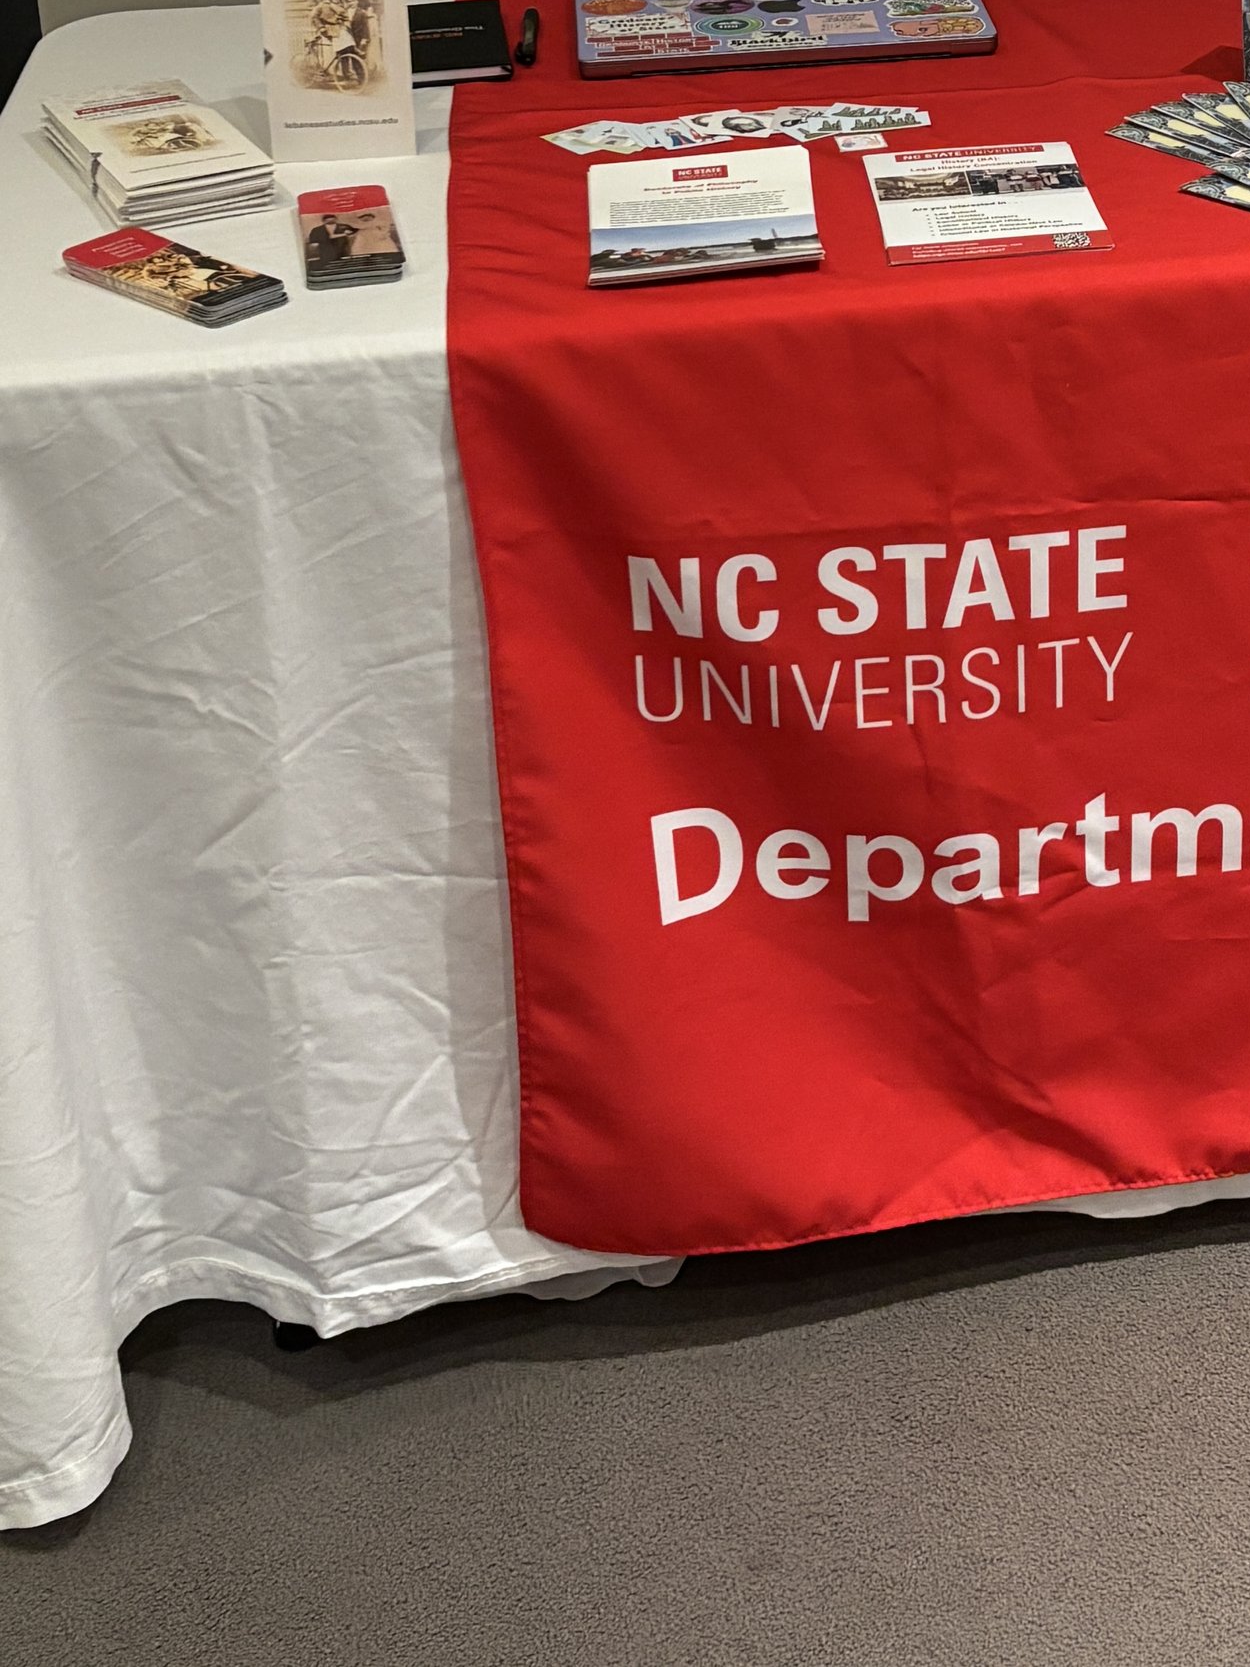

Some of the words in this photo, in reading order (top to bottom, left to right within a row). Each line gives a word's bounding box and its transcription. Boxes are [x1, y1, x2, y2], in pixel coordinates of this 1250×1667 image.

[965, 146, 1036, 156] UNIVERSITY
[631, 554, 778, 641] NC
[818, 526, 1127, 634] STATE
[636, 632, 1132, 730] UNIVERSITY
